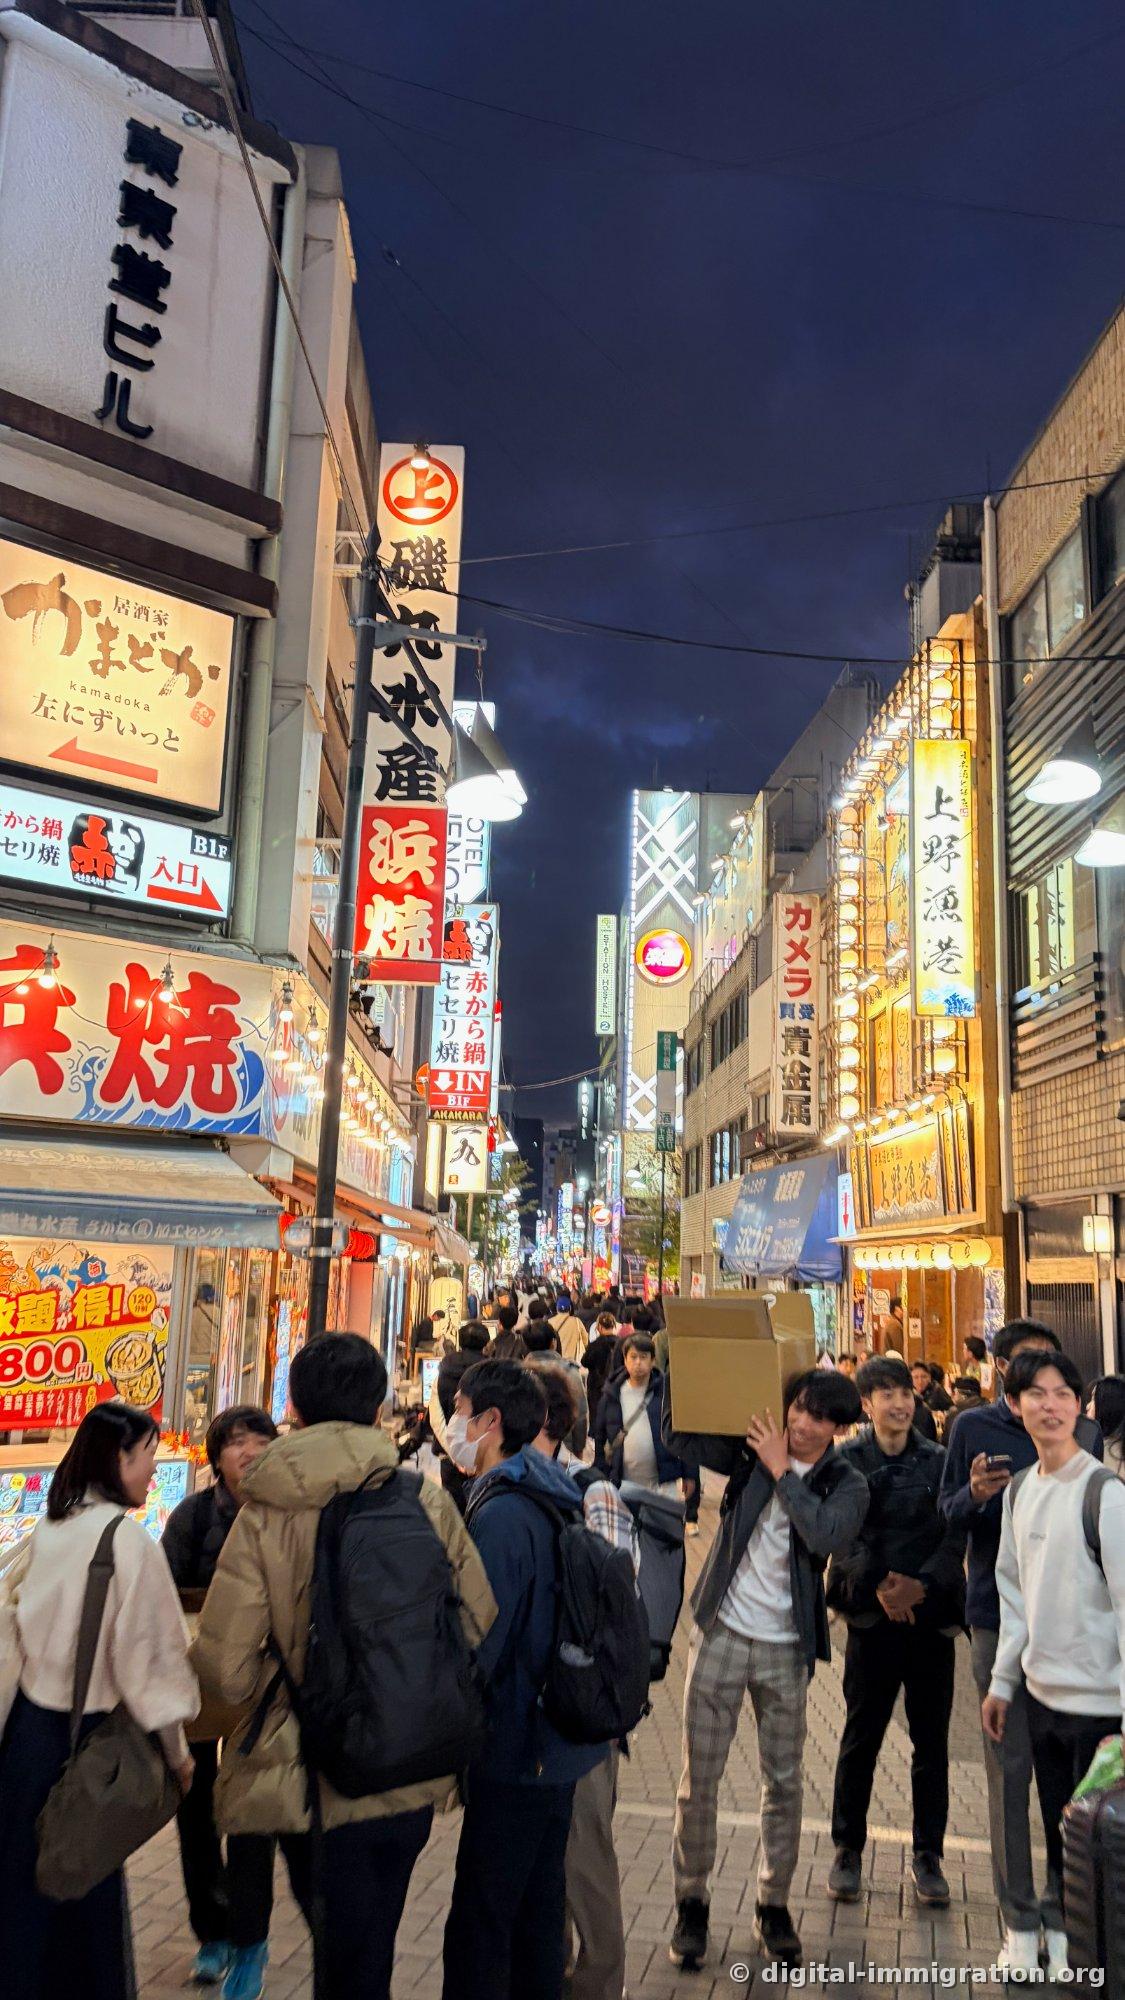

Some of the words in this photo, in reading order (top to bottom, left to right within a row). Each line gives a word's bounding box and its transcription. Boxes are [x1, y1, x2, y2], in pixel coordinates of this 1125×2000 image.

[113, 595, 170, 627] 居酒家
[1, 572, 221, 698] かまどか
[374, 534, 448, 802] 磯丸水産
[69, 680, 151, 712] kamadoka
[31, 691, 180, 752] 左にずいっと
[0, 810, 63, 842] から鍋
[193, 834, 228, 859] B1F
[465, 817, 485, 874] OTEL
[150, 856, 199, 888] 入口
[364, 818, 438, 960] 浜焼
[783, 902, 813, 998] カメラ
[436, 970, 461, 1064] セセリ焼
[463, 971, 488, 1064] 赤から鍋
[455, 1072, 486, 1092] IN
[433, 1109, 483, 1121] AKAKARA
[132, 1293, 151, 1306] 120
